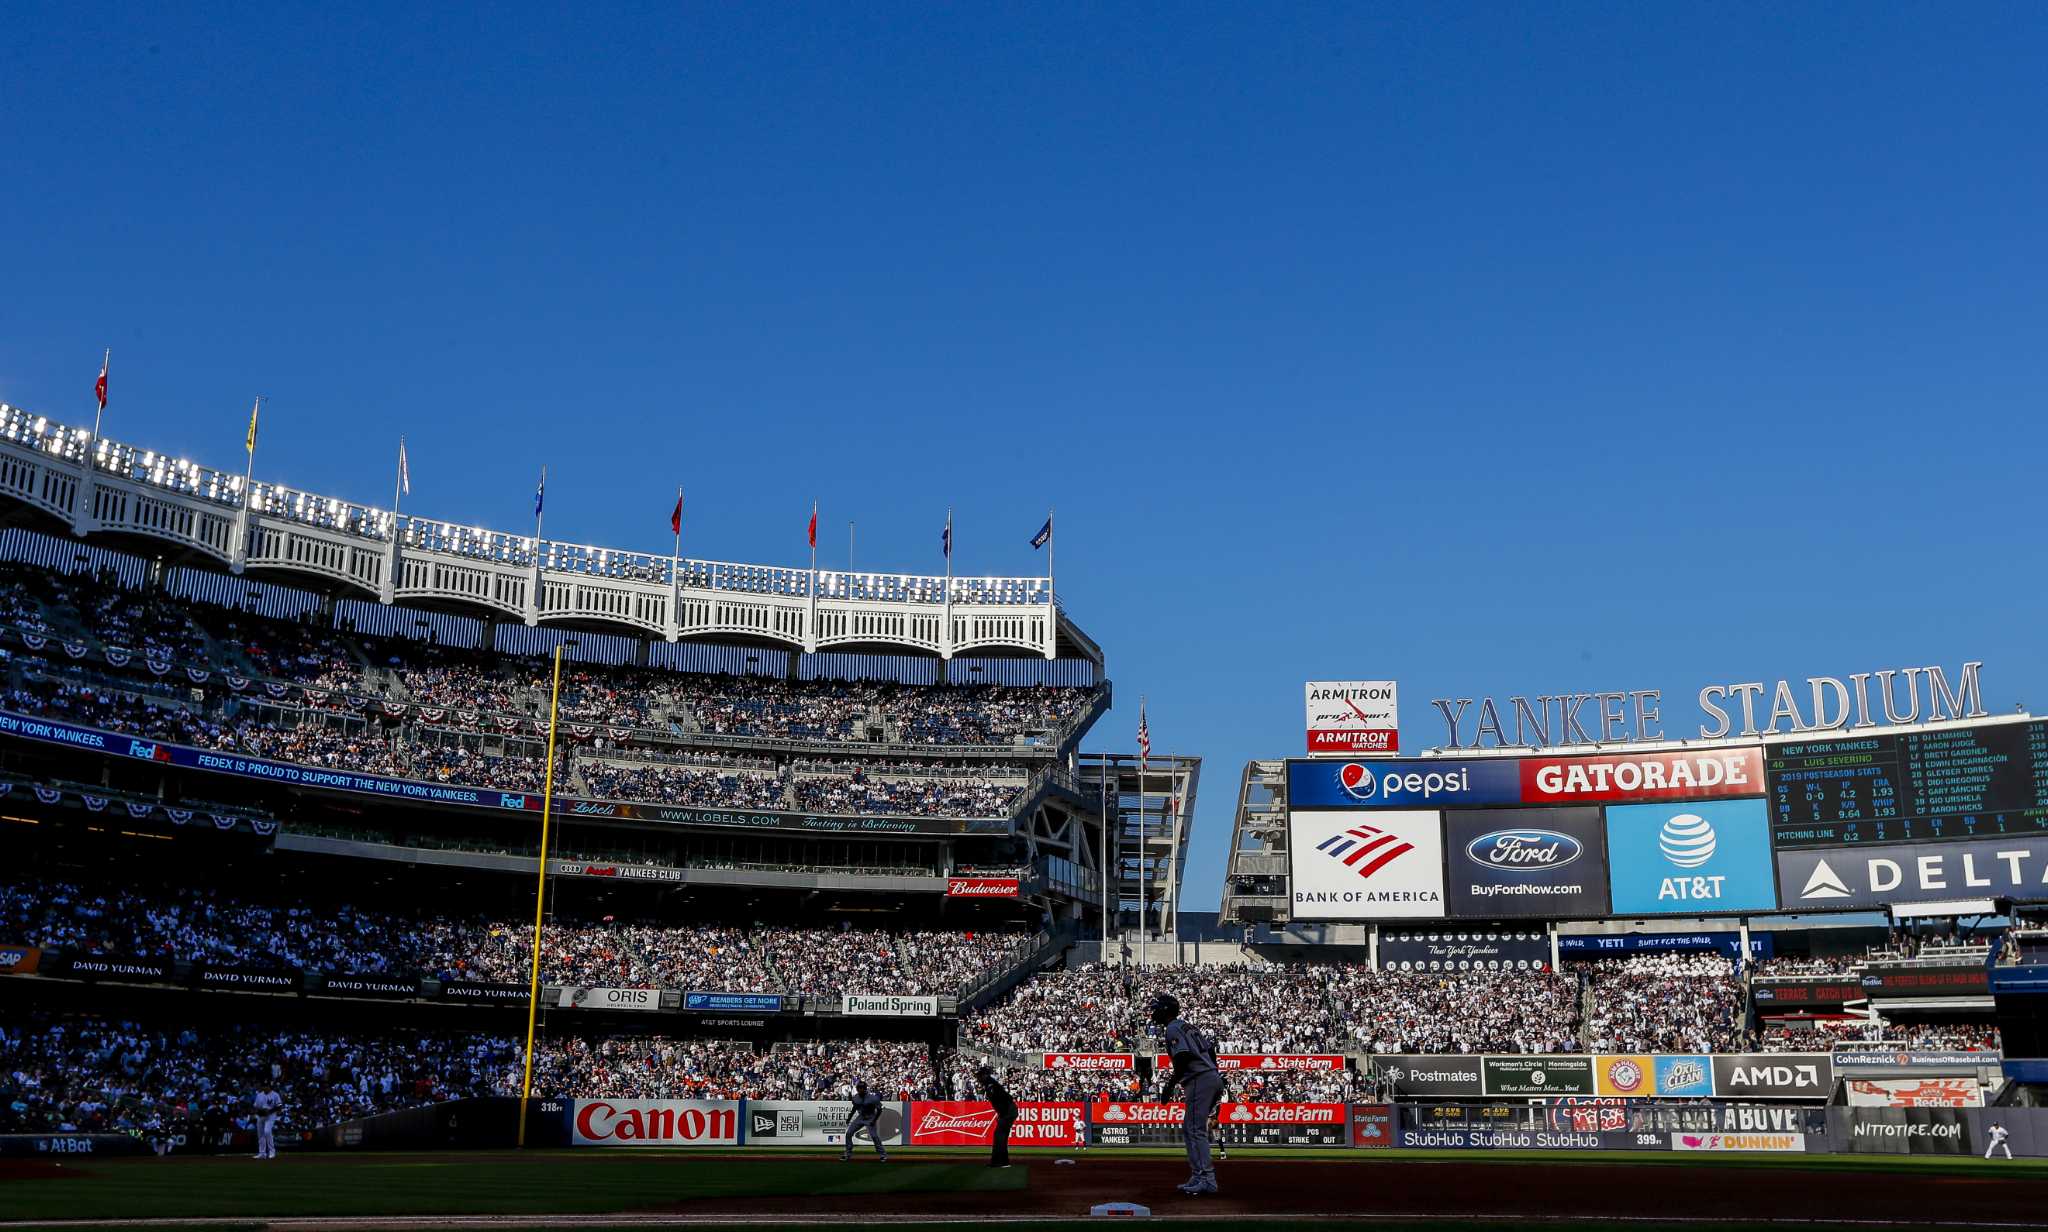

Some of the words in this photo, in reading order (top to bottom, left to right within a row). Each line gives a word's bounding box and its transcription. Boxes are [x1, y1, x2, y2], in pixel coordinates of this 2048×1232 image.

[1310, 689, 1391, 700] ARMITRON
[1432, 689, 1665, 750] YANKEE
[1699, 661, 1988, 738] STADIUM
[0, 716, 19, 730] EW
[21, 721, 50, 737] YORK
[53, 727, 105, 747] YANKEES.
[1316, 732, 1389, 743] ARMITRON
[1782, 746, 1804, 755] NEW
[1806, 743, 1832, 754] YORK
[1835, 740, 1880, 751] YANKEES
[1951, 740, 1976, 748] JUDGE
[129, 740, 170, 762] FedEx
[1950, 748, 1988, 757] GARDNER
[1804, 758, 1825, 767] LUIS
[1827, 754, 1872, 765] SEVERINO
[1536, 756, 1748, 794] GATORADE
[1781, 772, 1802, 781] 2019
[1804, 769, 1856, 780] POSTSEASON
[1857, 767, 1881, 776] STATS
[1926, 768, 1961, 777] GLEYBER
[1963, 766, 1994, 774] TORRES
[198, 755, 233, 770] FEDEX
[235, 760, 245, 771] IS
[248, 762, 284, 777] PROUD
[285, 768, 299, 779] TO
[302, 771, 352, 786] SUPPORT
[354, 777, 374, 789] THE
[376, 781, 400, 792] NEW
[402, 784, 429, 796] YORK
[430, 787, 479, 802] YANKEES.
[1382, 767, 1469, 798] pepsi
[1945, 775, 1990, 785] GREGORIUS
[1840, 790, 1856, 798] 4.2
[1872, 788, 1894, 797] 1.93
[1928, 787, 1949, 795] GARY
[660, 810, 780, 825] WWW.LOBELS.COM
[1838, 810, 1860, 818] 9.64
[1874, 808, 1895, 816] 1.93
[801, 817, 844, 830] Tasting
[861, 819, 916, 833] Believing
[1777, 830, 1814, 840] PITCHING
[1817, 829, 1834, 838] LINE
[1490, 834, 1560, 865] Ford
[619, 867, 657, 879] YANKEES
[659, 868, 681, 880] CLUB
[1867, 850, 2048, 892] DELT
[949, 881, 1017, 895] Budweiser
[1471, 882, 1582, 897] BuyFordNow.com
[1657, 876, 1726, 899] AT&T
[1296, 891, 1339, 903] BANK
[1343, 891, 1363, 902] OF
[1365, 890, 1439, 902] AMERICA
[1597, 939, 1624, 948] YETI
[1638, 939, 1659, 947] BUILT
[1427, 945, 1446, 955] New
[1447, 944, 1466, 958] York
[1467, 944, 1499, 958] Yankees
[73, 961, 107, 972] DAVID
[111, 963, 163, 976] YURMAN
[204, 972, 239, 982] DAVID
[243, 974, 292, 986] YURMAN
[328, 981, 362, 990] DAVID
[366, 982, 415, 993] YURMAN
[447, 987, 481, 996] DAVID
[607, 990, 648, 1002] ORIS
[848, 997, 888, 1013] Poland
[891, 997, 931, 1016] Spring
[1524, 1060, 1543, 1068] Circle
[1837, 1055, 1895, 1065] CohnReznick
[1912, 1056, 1998, 1064] BusinessOfBaseball.com
[1410, 1069, 1477, 1082] Postmates
[1673, 1064, 1695, 1076] OXI
[1730, 1067, 1792, 1086] AMD
[1667, 1071, 1702, 1087] CLEAN
[781, 1116, 799, 1124] NEW
[1016, 1107, 1038, 1122] HIS
[1041, 1108, 1081, 1122] BUD'S
[1724, 1103, 1798, 1131] ABOVE
[577, 1103, 735, 1140] Canon
[922, 1115, 992, 1128] Budweiser
[1009, 1124, 1034, 1138] FOR
[1037, 1124, 1068, 1138] YOU.
[1102, 1127, 1128, 1135] ASTROS
[1854, 1121, 1961, 1139] NITTOTIRE.COM
[1101, 1136, 1130, 1144] YANKEES
[1253, 1136, 1268, 1144] BALL
[1288, 1136, 1310, 1144] STRIKE
[1323, 1136, 1335, 1144] OUT
[1404, 1132, 1464, 1147] StubHub
[1470, 1132, 1530, 1147] StubHub
[1536, 1132, 1599, 1147] StubHub
[1723, 1136, 1795, 1149] DUNKIN'
